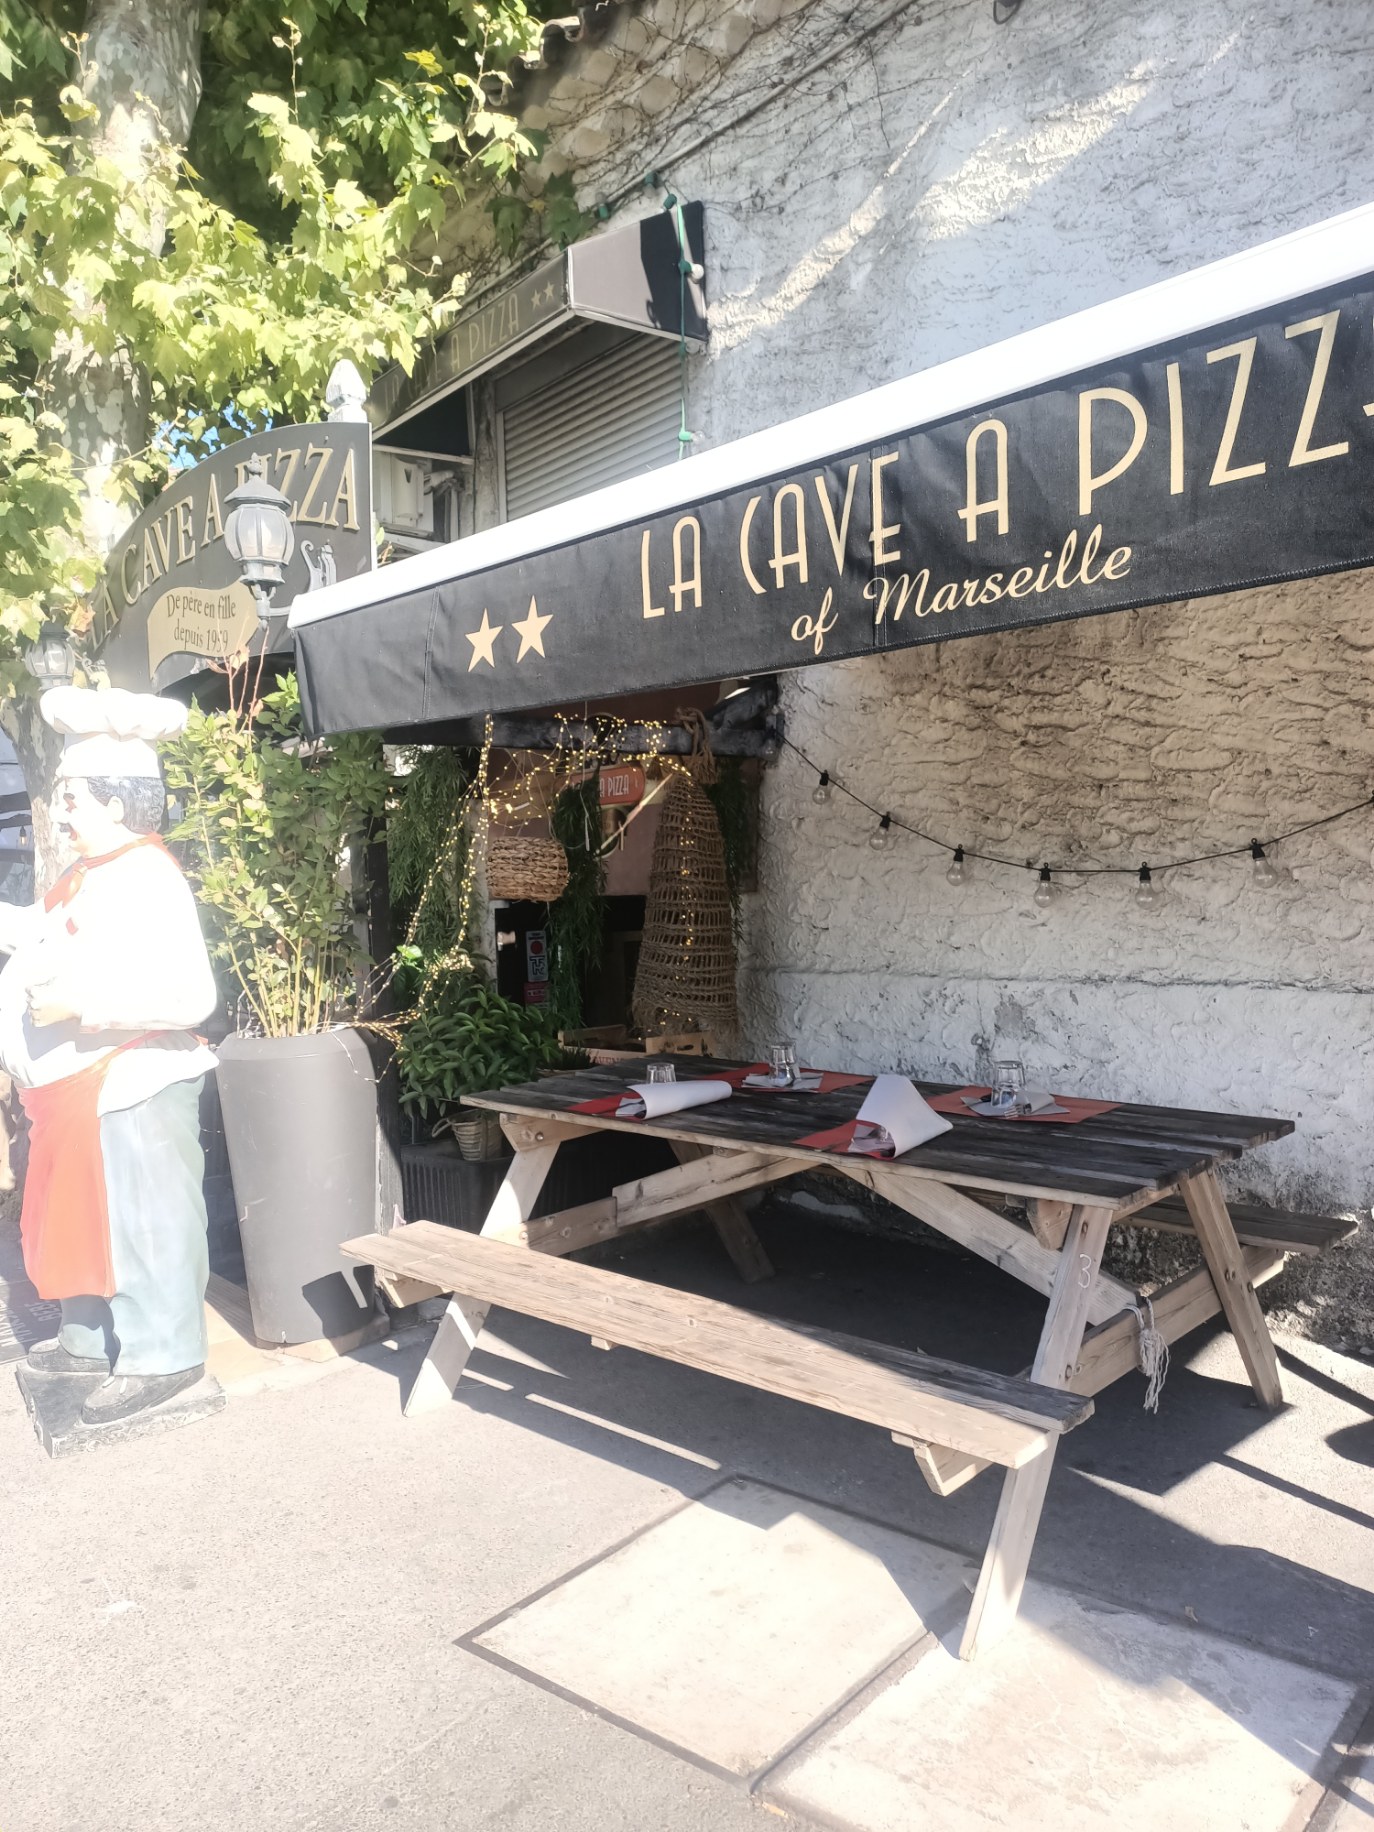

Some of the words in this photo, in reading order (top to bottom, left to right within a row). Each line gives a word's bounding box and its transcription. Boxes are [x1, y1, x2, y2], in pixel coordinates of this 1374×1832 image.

[450, 333, 461, 374] A
[468, 292, 520, 361] PIZZA
[640, 514, 702, 618] LA
[738, 451, 902, 595] CAVE
[957, 418, 1010, 543] A
[1077, 309, 1374, 516] PIZZ
[121, 496, 196, 606] CAVE
[200, 473, 225, 548] A
[167, 594, 181, 618] De
[182, 590, 203, 618] père
[204, 602, 215, 619] en
[218, 594, 236, 620] fille
[790, 587, 839, 655] of
[862, 522, 1133, 626] Marseille
[174, 618, 204, 651] depuis
[607, 774, 630, 797] PIZZA
[1078, 1253, 1092, 1289] 3
